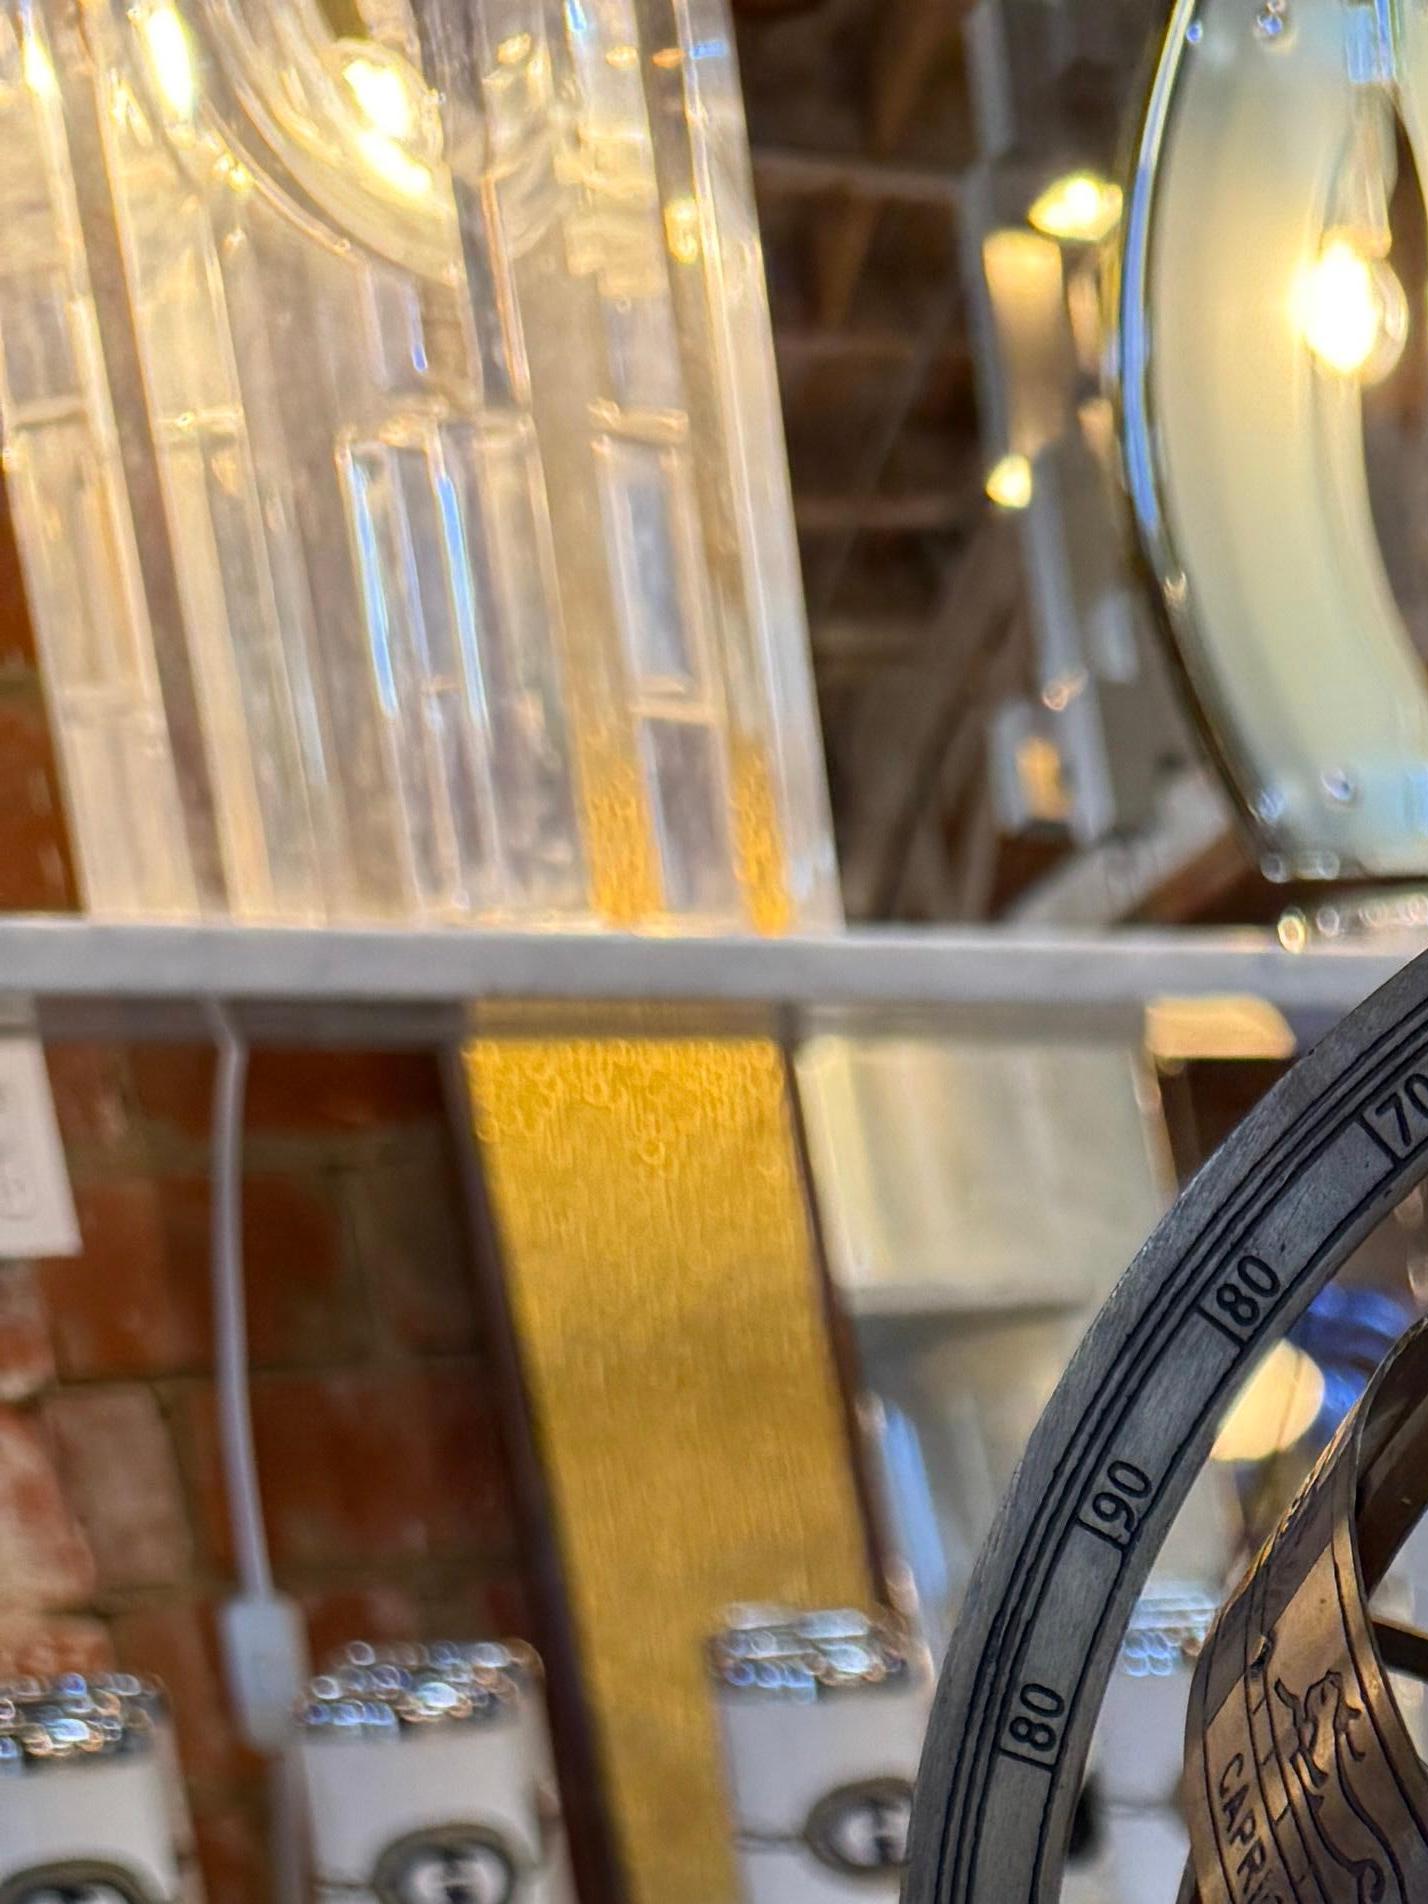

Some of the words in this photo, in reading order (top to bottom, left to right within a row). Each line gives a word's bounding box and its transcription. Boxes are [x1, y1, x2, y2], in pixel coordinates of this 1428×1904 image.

[1216, 1255, 1282, 1328] 80
[1091, 1459, 1152, 1540] 90
[1010, 1682, 1066, 1753] 80
